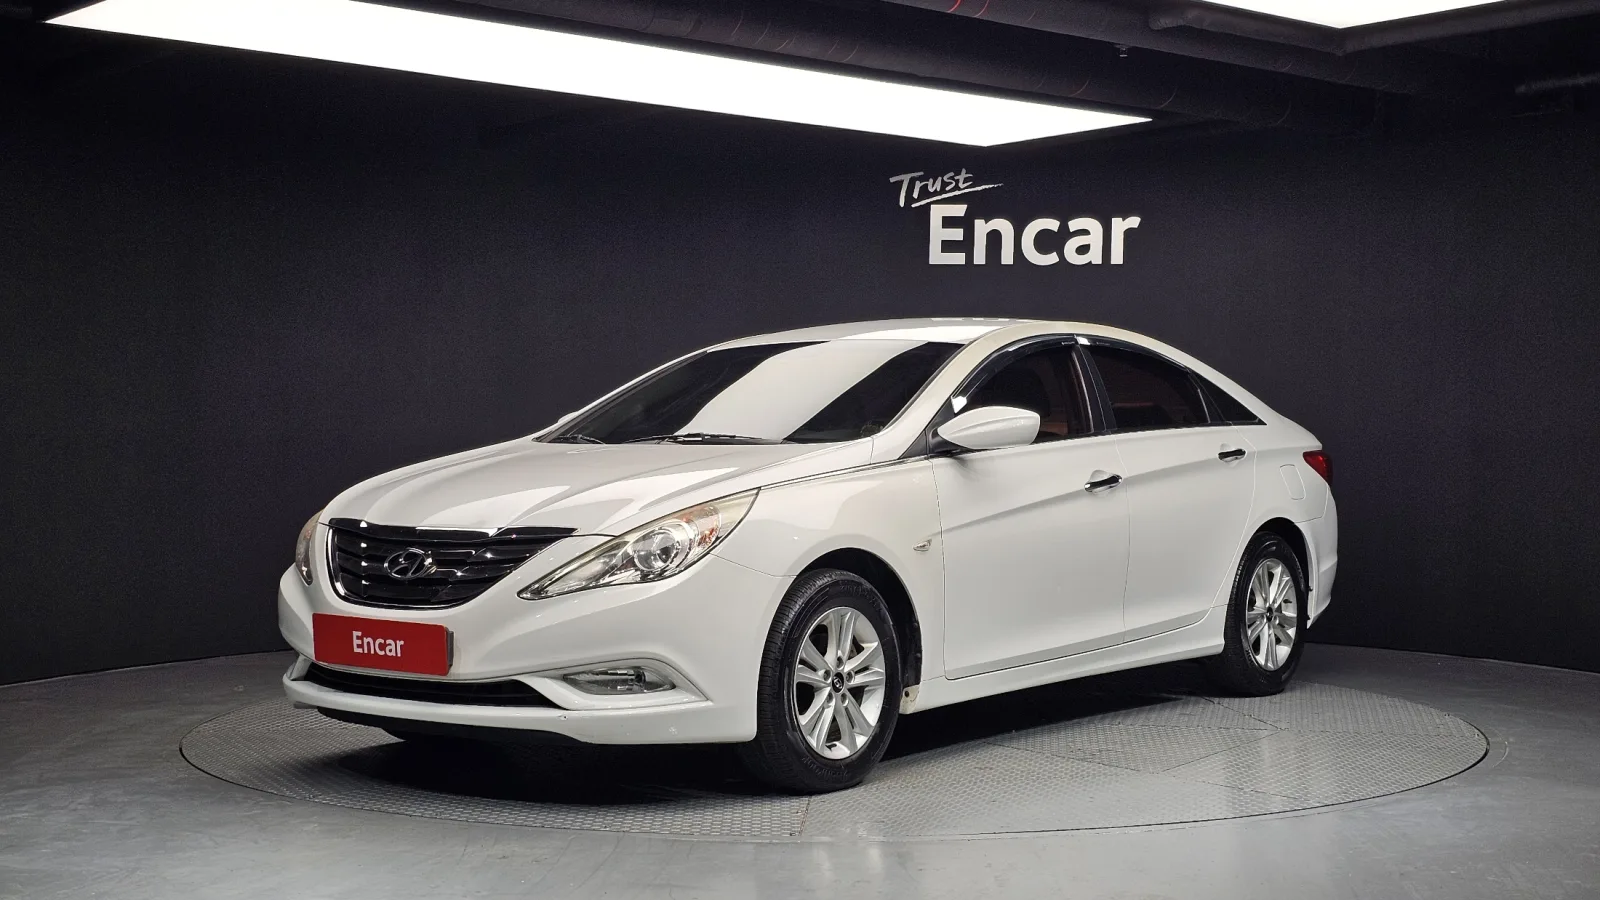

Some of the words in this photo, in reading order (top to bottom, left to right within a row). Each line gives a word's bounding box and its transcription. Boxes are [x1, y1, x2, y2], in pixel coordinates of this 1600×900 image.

[889, 168, 974, 208] Trust
[928, 204, 1141, 266] Encar
[352, 630, 405, 657] Encar
